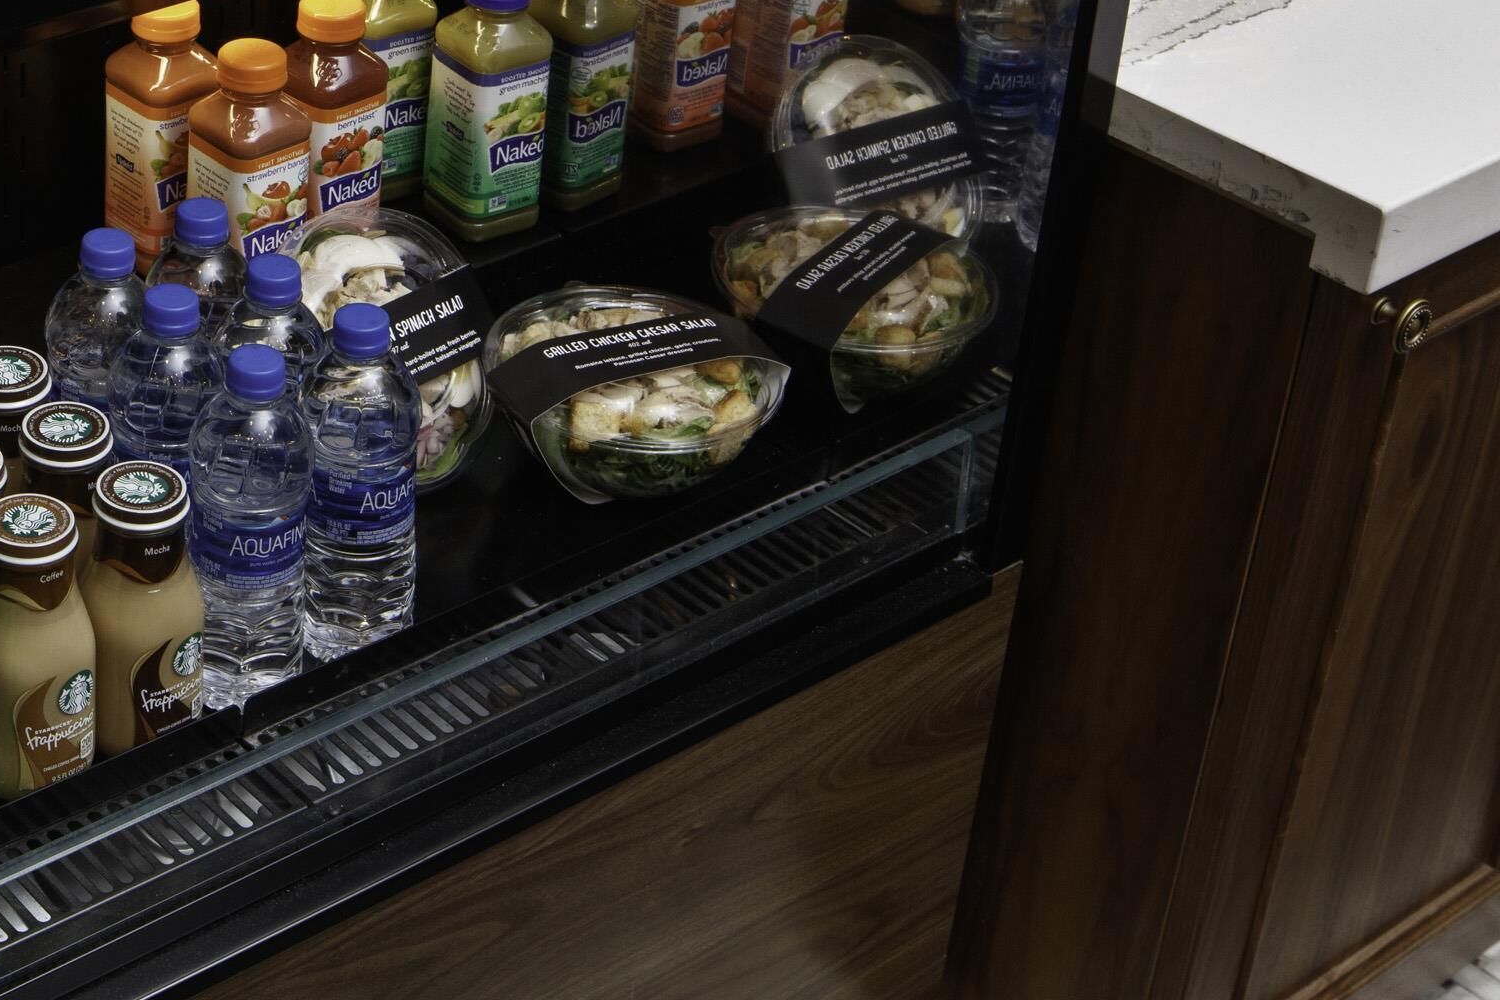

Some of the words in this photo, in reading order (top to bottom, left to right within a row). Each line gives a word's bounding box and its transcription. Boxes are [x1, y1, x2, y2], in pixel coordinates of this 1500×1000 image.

[387, 47, 410, 60] green
[500, 72, 526, 84] BOOSTED
[499, 83, 522, 97] green
[336, 111, 353, 120] FRUIT
[337, 118, 358, 131] berry
[358, 110, 378, 123] blast
[495, 138, 544, 166] Naked
[258, 158, 276, 170] FRUIT
[246, 165, 287, 183] strawberry
[327, 170, 379, 206] Naked
[395, 309, 436, 338] SPINACH
[435, 294, 464, 319] SALAD
[543, 340, 589, 359] GRILLED
[589, 331, 638, 349] CHICKEN
[637, 323, 682, 338] CAESAR
[680, 317, 717, 331] SALAD
[641, 339, 652, 347] cal
[400, 341, 411, 352] cal
[404, 349, 436, 367] hard-boiled
[447, 336, 461, 347] fresh
[435, 348, 459, 363] balsamic
[458, 336, 482, 352] vinaigrette
[574, 360, 603, 371] Romaine
[627, 349, 648, 360] grilled
[673, 341, 691, 350] garlic
[613, 356, 645, 367] Parmesan
[645, 352, 666, 361] Caesar
[666, 346, 694, 357] dressing
[0, 423, 22, 433] Moch
[328, 484, 346, 494] Water
[144, 545, 171, 556] Mocha
[40, 569, 64, 584] Coffee
[150, 680, 186, 697] STARBUCKS
[25, 710, 94, 752] frappuccino
[34, 719, 73, 735] STARBUCKS
[51, 774, 62, 783] 9.5
[62, 772, 68, 780] FL
